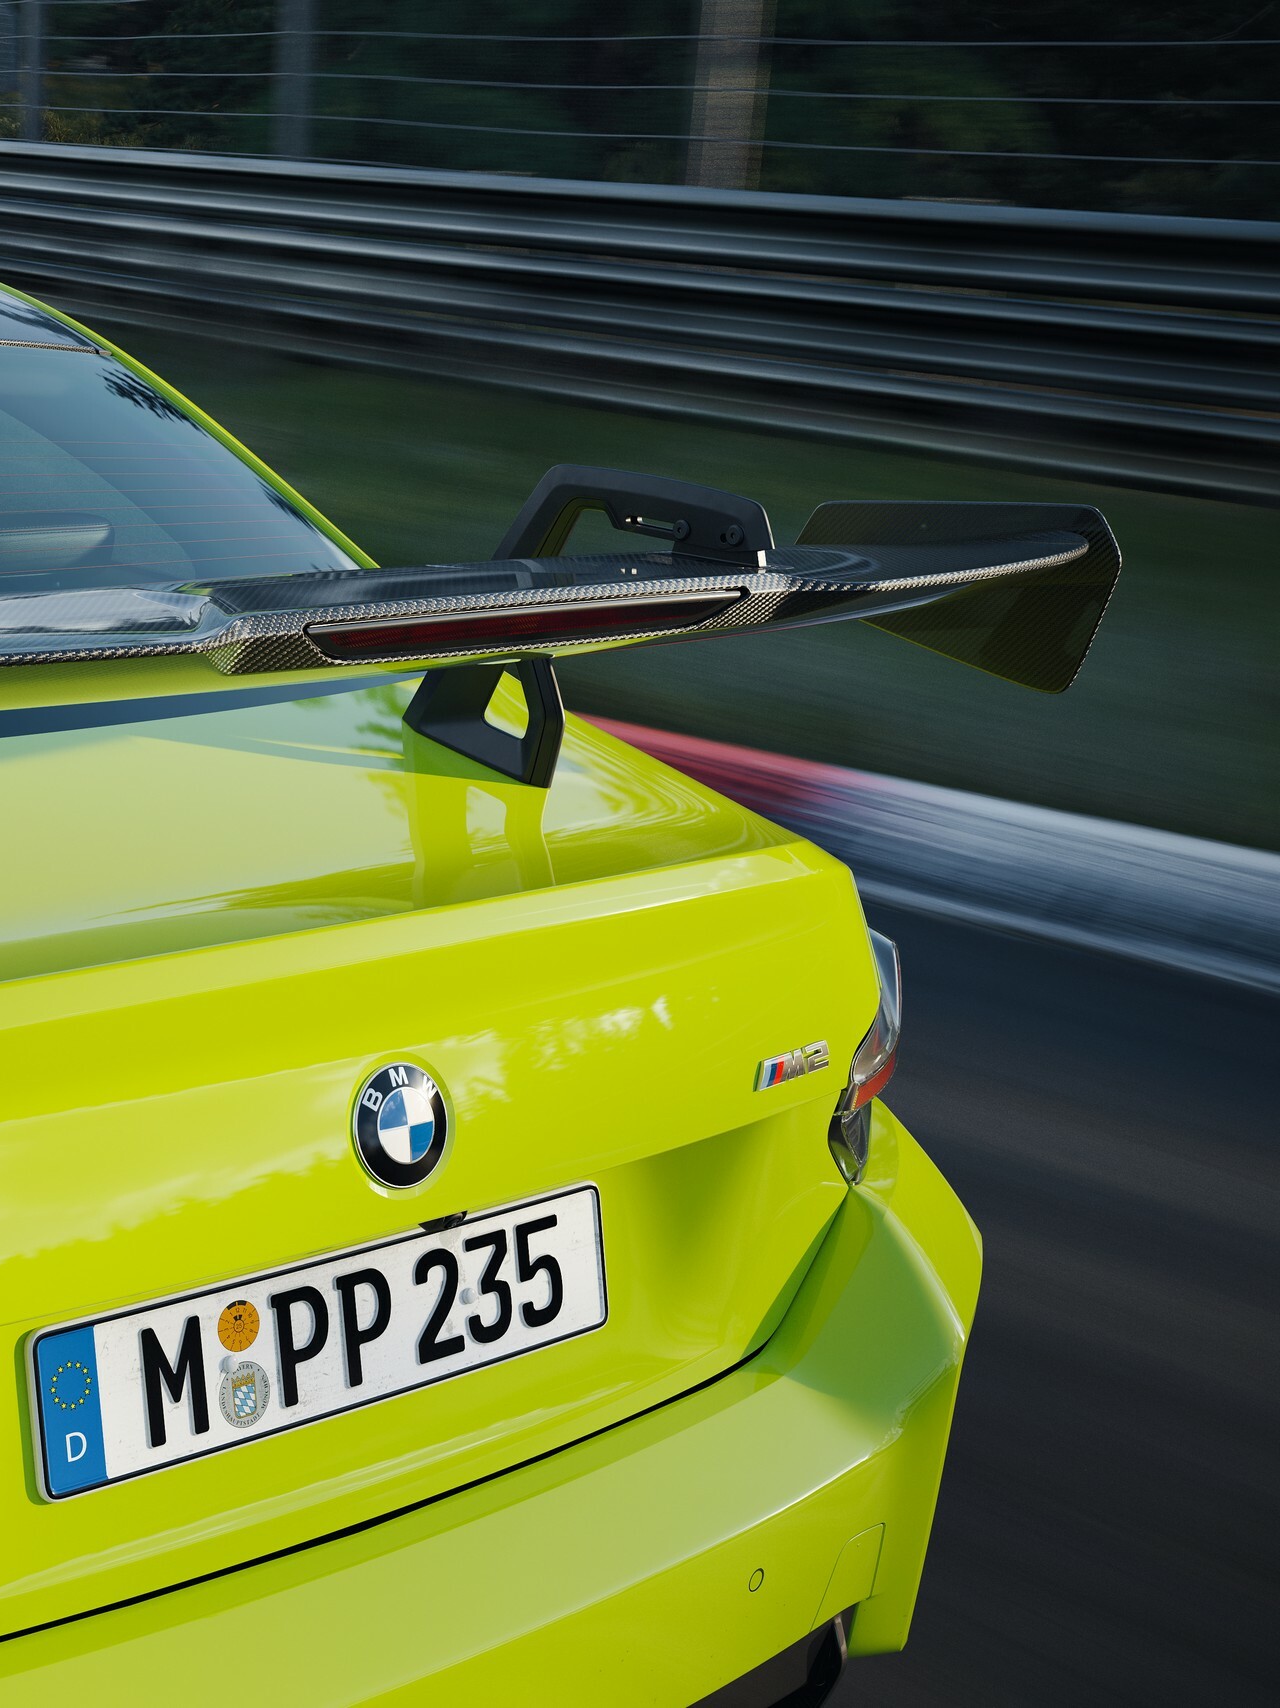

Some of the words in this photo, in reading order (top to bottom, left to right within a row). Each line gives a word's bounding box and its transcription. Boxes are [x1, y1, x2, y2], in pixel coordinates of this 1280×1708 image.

[362, 1066, 438, 1112] BMW
[760, 1040, 830, 1091] M2
[141, 1315, 210, 1448] M
[270, 1267, 392, 1408] PP
[413, 1213, 564, 1365] 235
[65, 1431, 88, 1463] D
